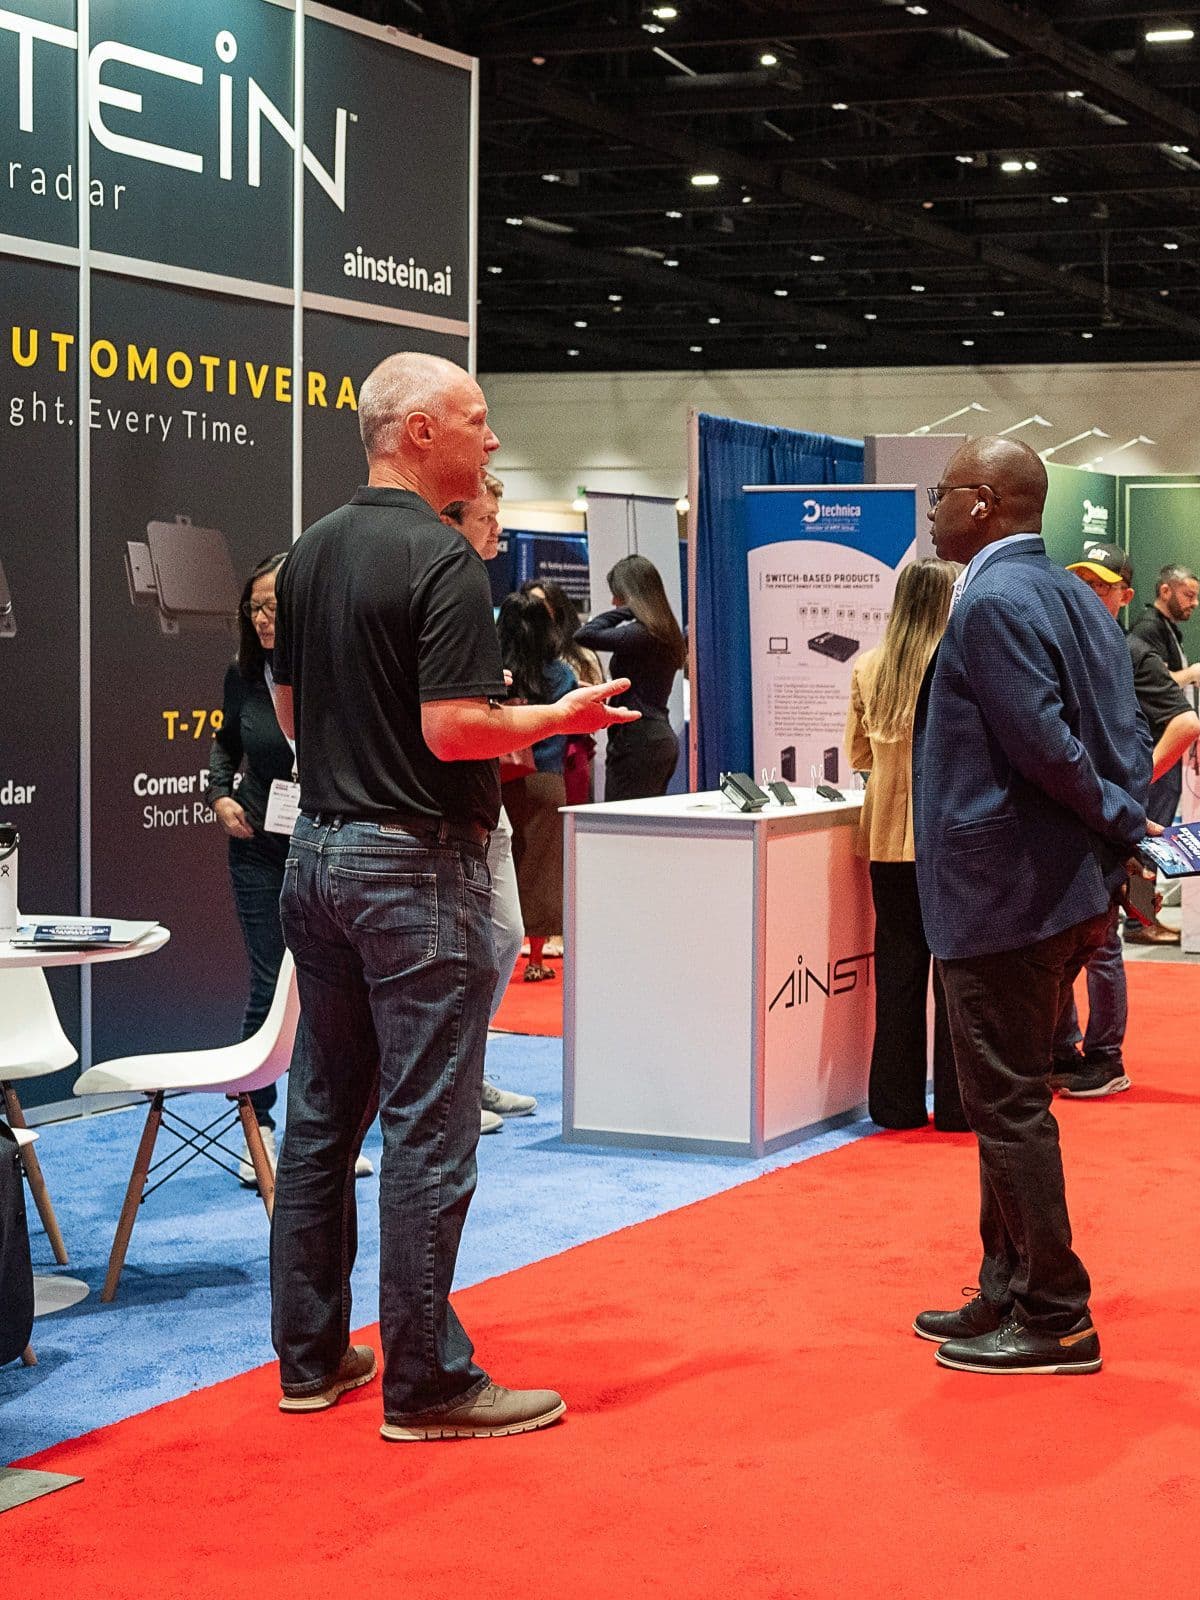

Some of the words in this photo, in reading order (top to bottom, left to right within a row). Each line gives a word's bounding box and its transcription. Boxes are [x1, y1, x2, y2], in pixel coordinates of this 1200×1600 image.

[8, 160, 126, 210] radar
[343, 246, 452, 296] ainstein.ai
[9, 391, 74, 427] ght.
[89, 399, 172, 440] Every
[182, 410, 255, 446] Time.
[821, 504, 861, 517] technica
[765, 573, 831, 583] SWITCH-BASED
[834, 573, 880, 583] PRODUCTS
[162, 709, 224, 740] T-79
[0, 779, 37, 806] dar
[133, 772, 197, 797] Corner
[143, 804, 189, 829] Short
